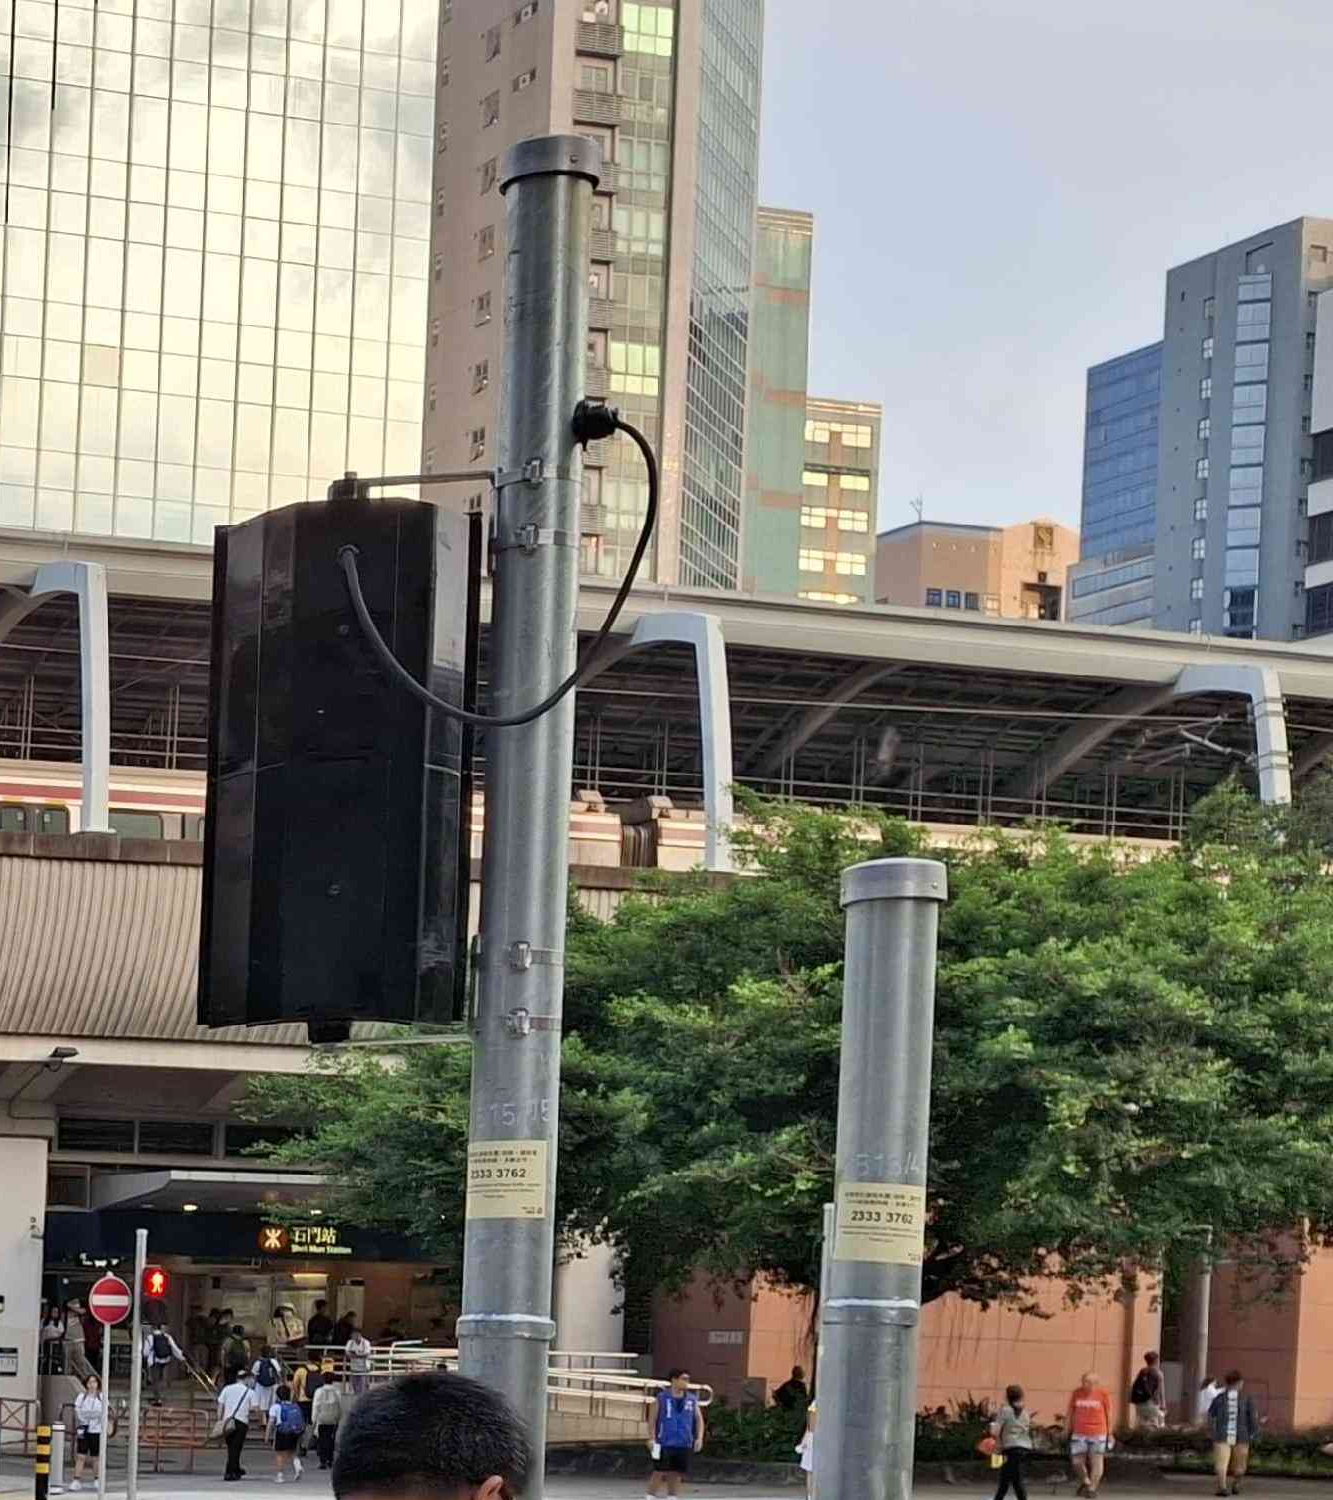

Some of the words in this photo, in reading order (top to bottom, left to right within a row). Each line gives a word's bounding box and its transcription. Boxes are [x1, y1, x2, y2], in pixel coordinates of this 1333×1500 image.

[496, 1168, 526, 1178] 3762
[851, 1210, 882, 1222] 2333
[886, 1212, 914, 1224] 3762
[292, 1226, 337, 1244] 石門站
